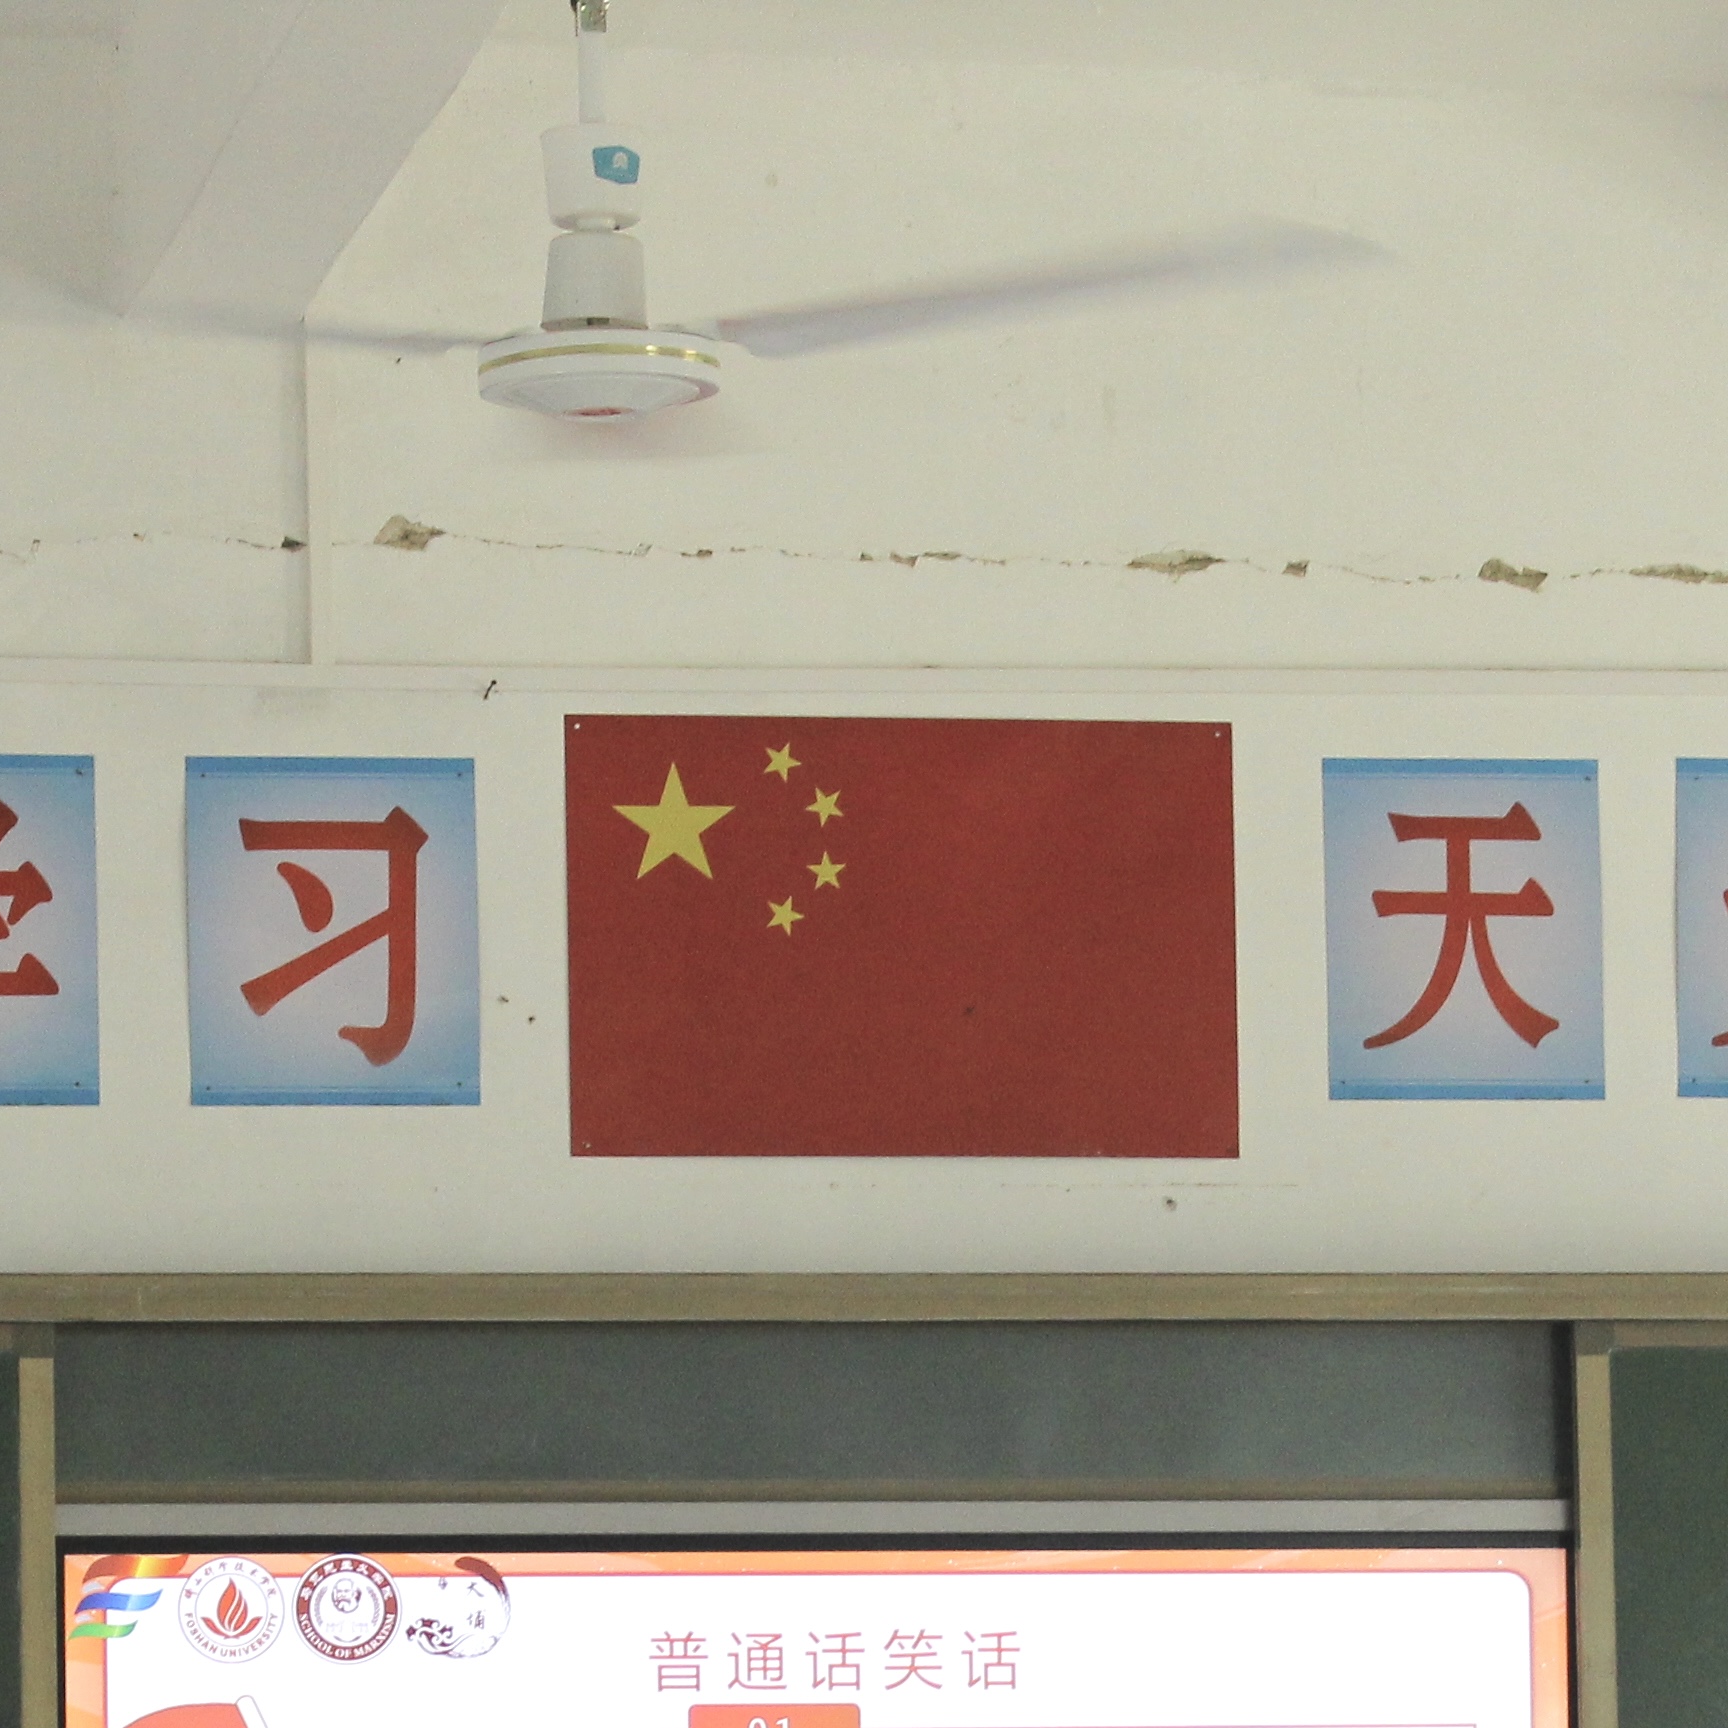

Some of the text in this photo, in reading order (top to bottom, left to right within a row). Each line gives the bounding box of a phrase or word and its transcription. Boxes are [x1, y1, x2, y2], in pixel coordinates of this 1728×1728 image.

[184, 1612, 278, 1658] FOSHAN UNIVERSITY
[299, 1613, 334, 1657] SCHOOL
[334, 1647, 353, 1659] OF
[648, 1628, 1021, 1692] 普通话笑话
